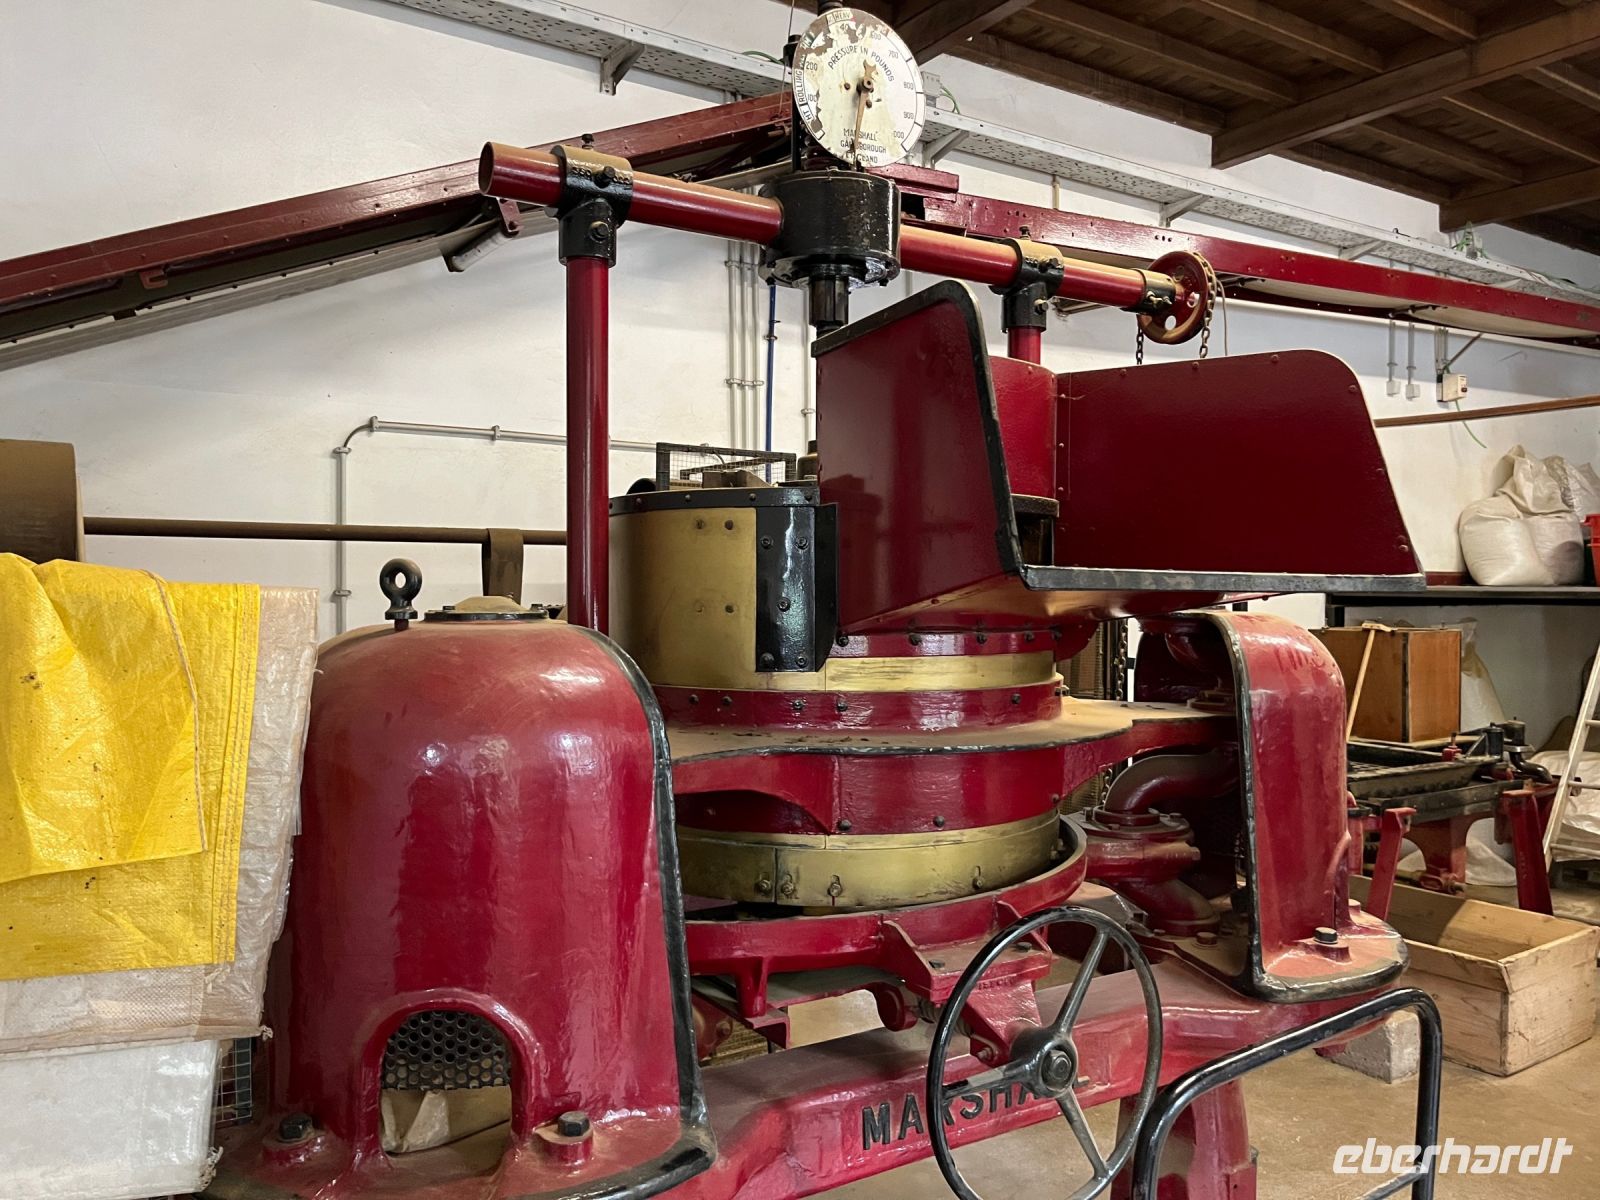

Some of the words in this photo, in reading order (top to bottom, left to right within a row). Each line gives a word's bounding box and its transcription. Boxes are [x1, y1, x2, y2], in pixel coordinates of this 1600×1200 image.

[888, 49, 899, 60] 700
[805, 60, 818, 72] 200
[828, 45, 858, 70] PRESSURE
[860, 45, 869, 56] IN
[871, 51, 895, 82] POUNDS
[795, 69, 806, 103] ROLLING
[843, 128, 878, 142] MASHALL
